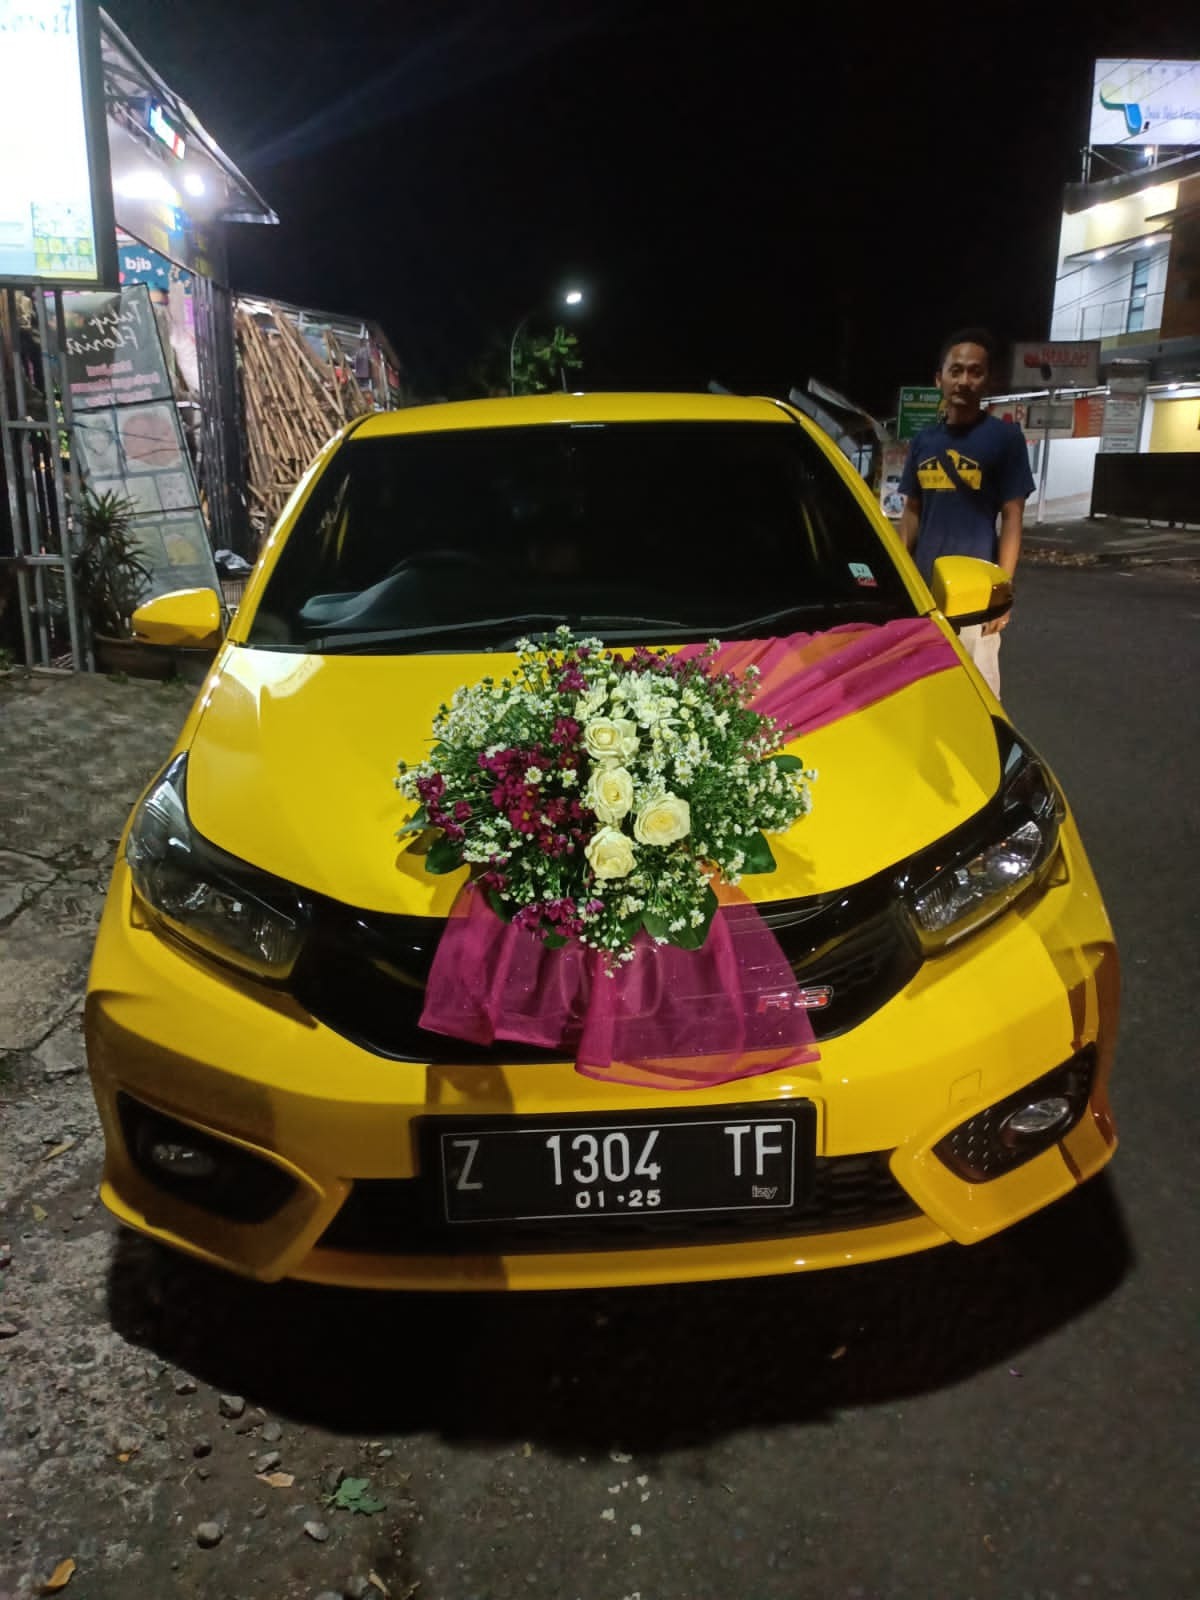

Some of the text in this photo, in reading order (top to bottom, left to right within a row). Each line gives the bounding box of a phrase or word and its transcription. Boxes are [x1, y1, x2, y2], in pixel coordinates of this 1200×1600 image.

[125, 257, 152, 273] bjb
[452, 1124, 783, 1191] Z 1304 TF
